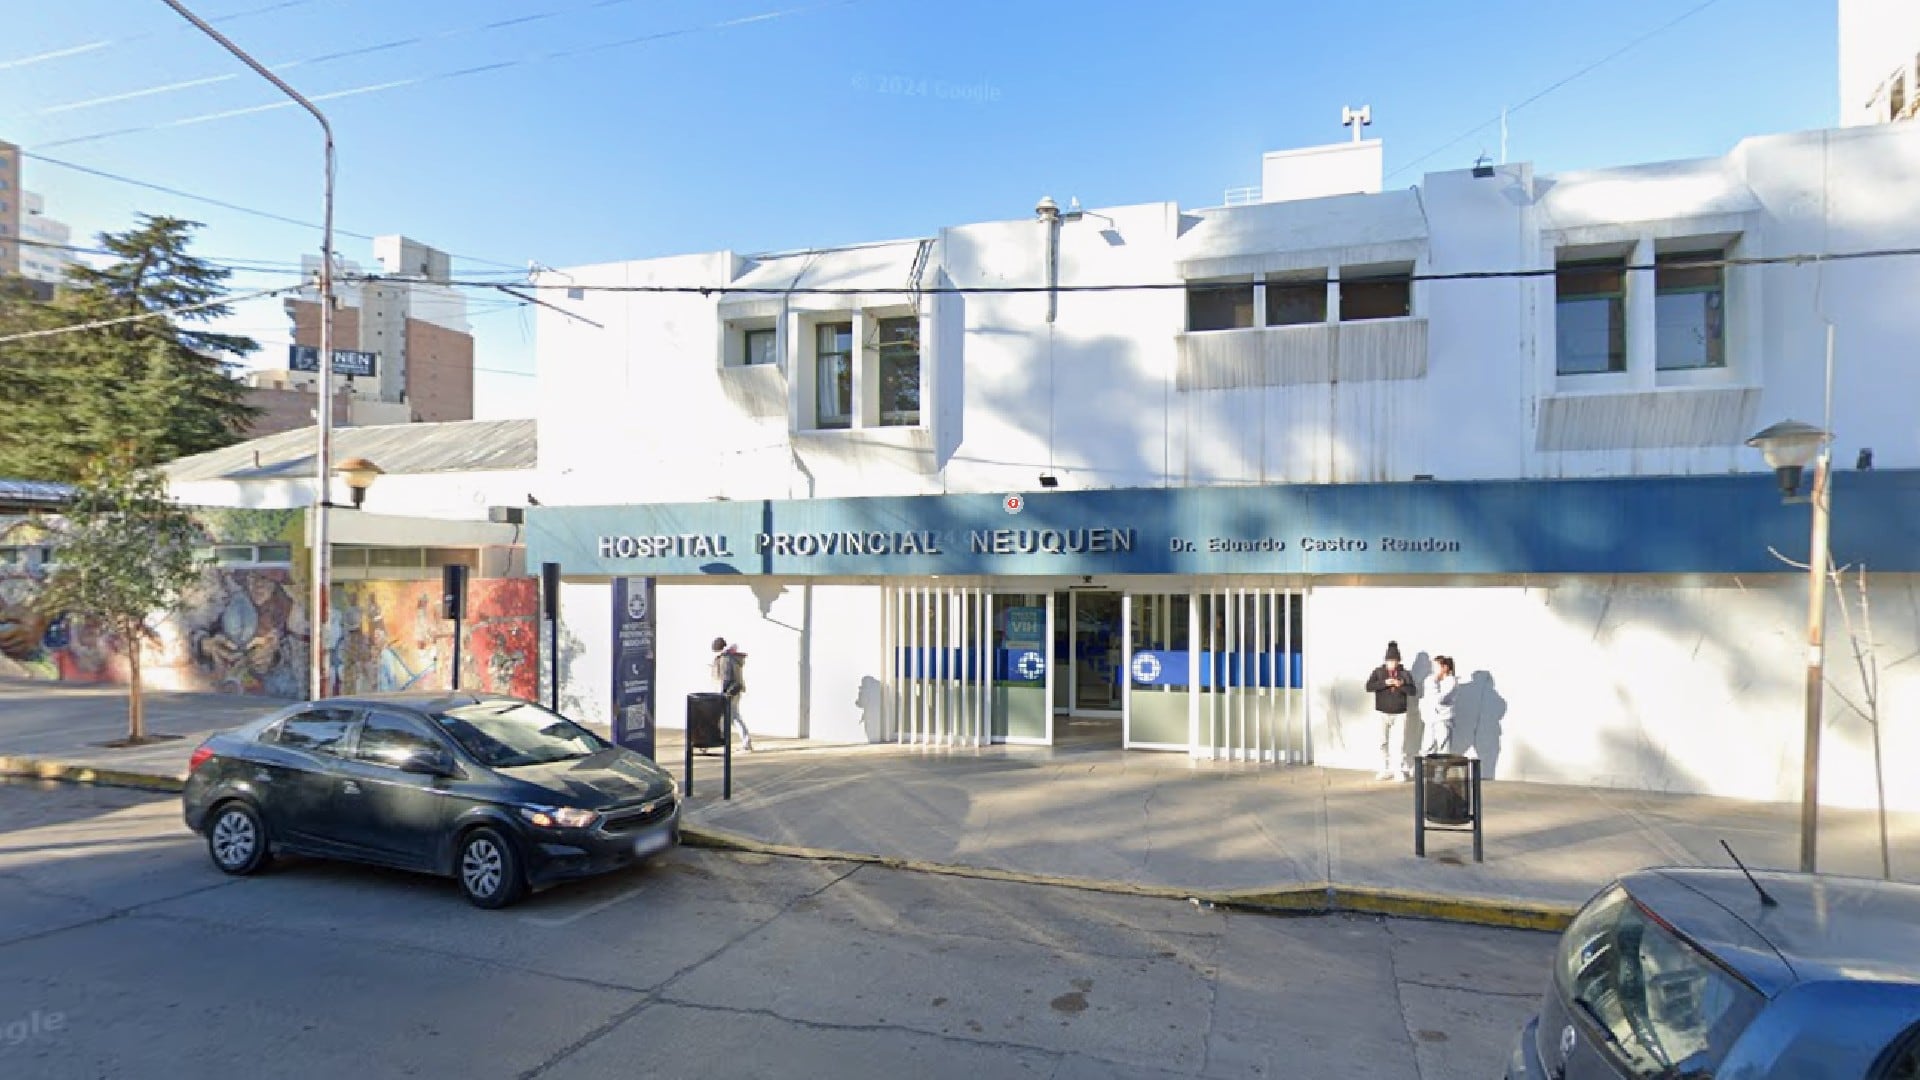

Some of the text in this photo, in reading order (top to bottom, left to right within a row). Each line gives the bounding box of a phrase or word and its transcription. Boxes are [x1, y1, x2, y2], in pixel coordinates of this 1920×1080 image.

[598, 533, 731, 558] HOSPITAL
[757, 530, 938, 555] PROVINCIAL
[970, 527, 1132, 553] NEUQUEN
[1170, 537, 1460, 552] Dr. Eduardo Castro Rendon
